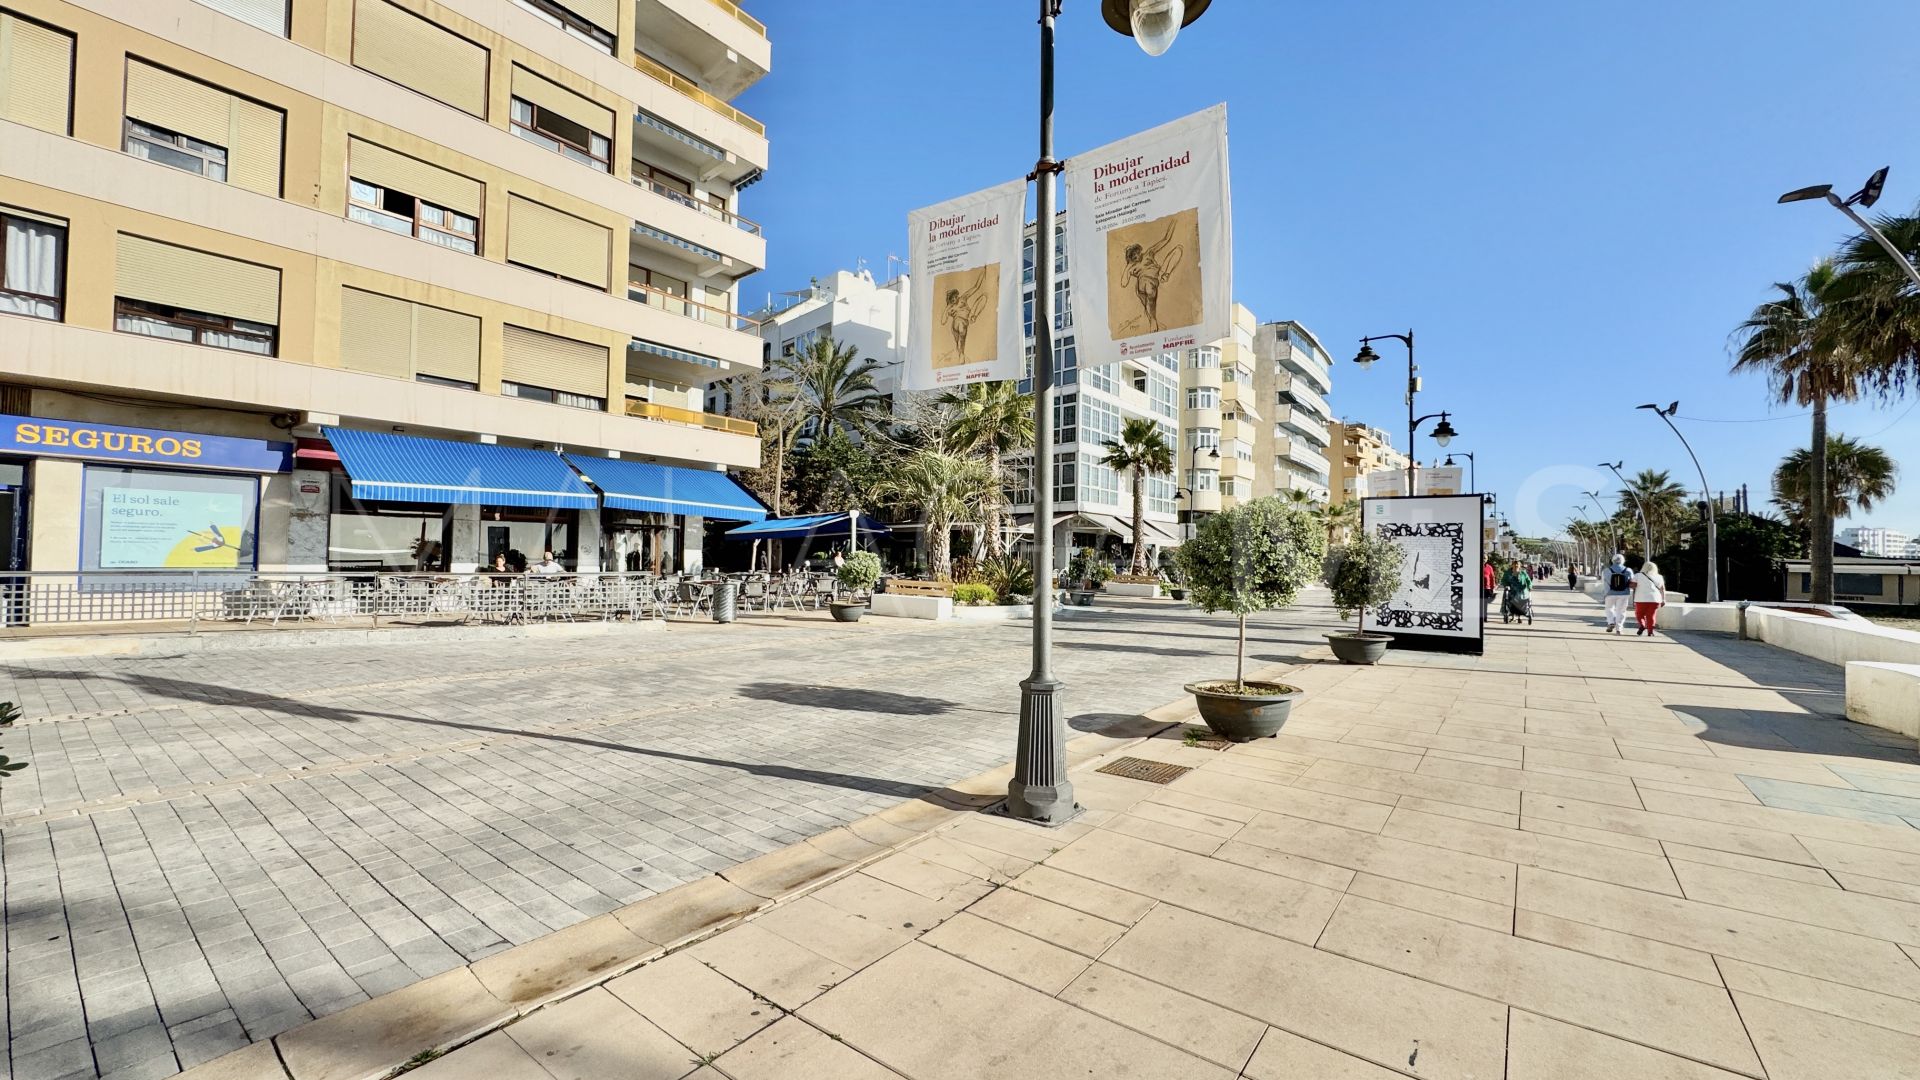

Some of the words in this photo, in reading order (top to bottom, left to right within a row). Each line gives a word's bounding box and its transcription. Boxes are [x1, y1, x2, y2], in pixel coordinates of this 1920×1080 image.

[1093, 155, 1144, 180] Dibujar
[1094, 181, 1105, 194] la
[1109, 150, 1191, 188] modernidad
[928, 233, 936, 243] la
[939, 213, 999, 239] modernidad
[929, 213, 966, 231] Dibujar
[1162, 338, 1195, 349] MAPFRE
[15, 423, 203, 458] SEGUROS
[112, 494, 126, 504] El
[129, 495, 149, 505] sol
[153, 496, 180, 506] sale
[111, 506, 163, 518] seguro.
